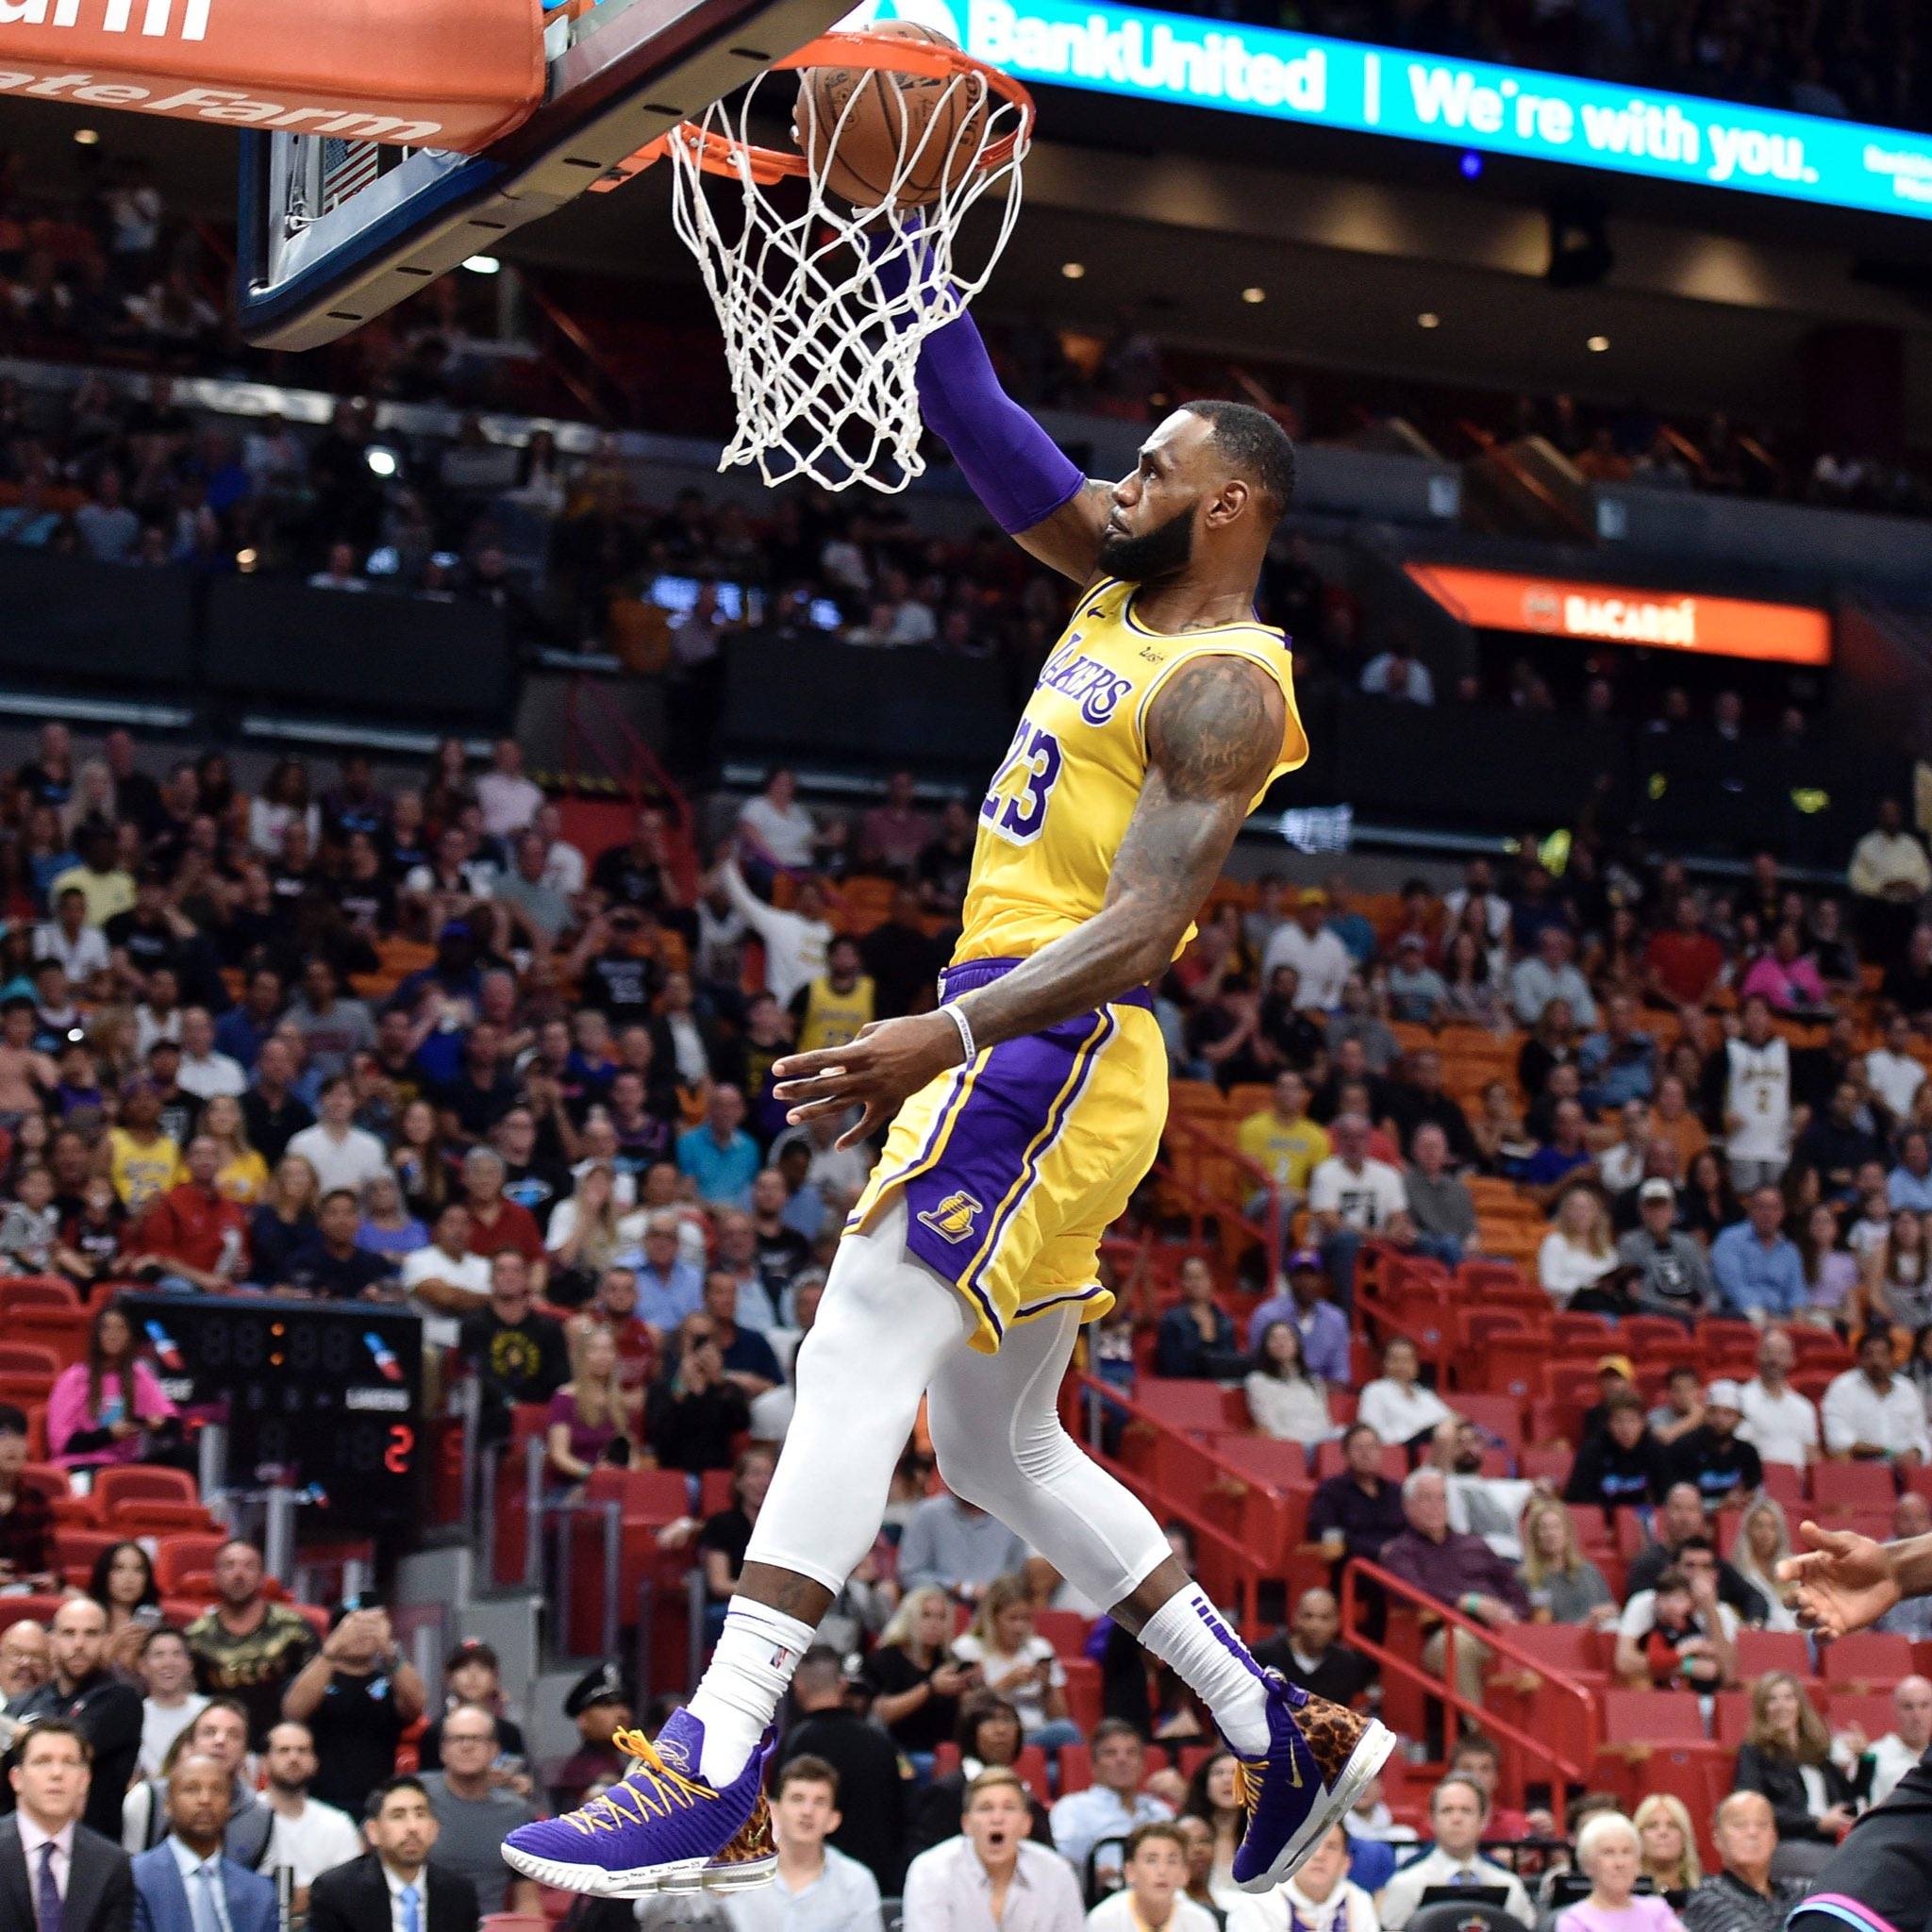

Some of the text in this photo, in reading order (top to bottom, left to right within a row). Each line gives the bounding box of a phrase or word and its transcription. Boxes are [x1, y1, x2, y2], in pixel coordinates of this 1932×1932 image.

[969, 0, 1327, 112] BankUnited
[142, 88, 442, 141] Farm
[1407, 64, 1574, 144] We're
[1582, 100, 1700, 164] with
[1707, 125, 1819, 183] you.
[980, 717, 1062, 840] 23
[385, 1425, 414, 1474] 2
